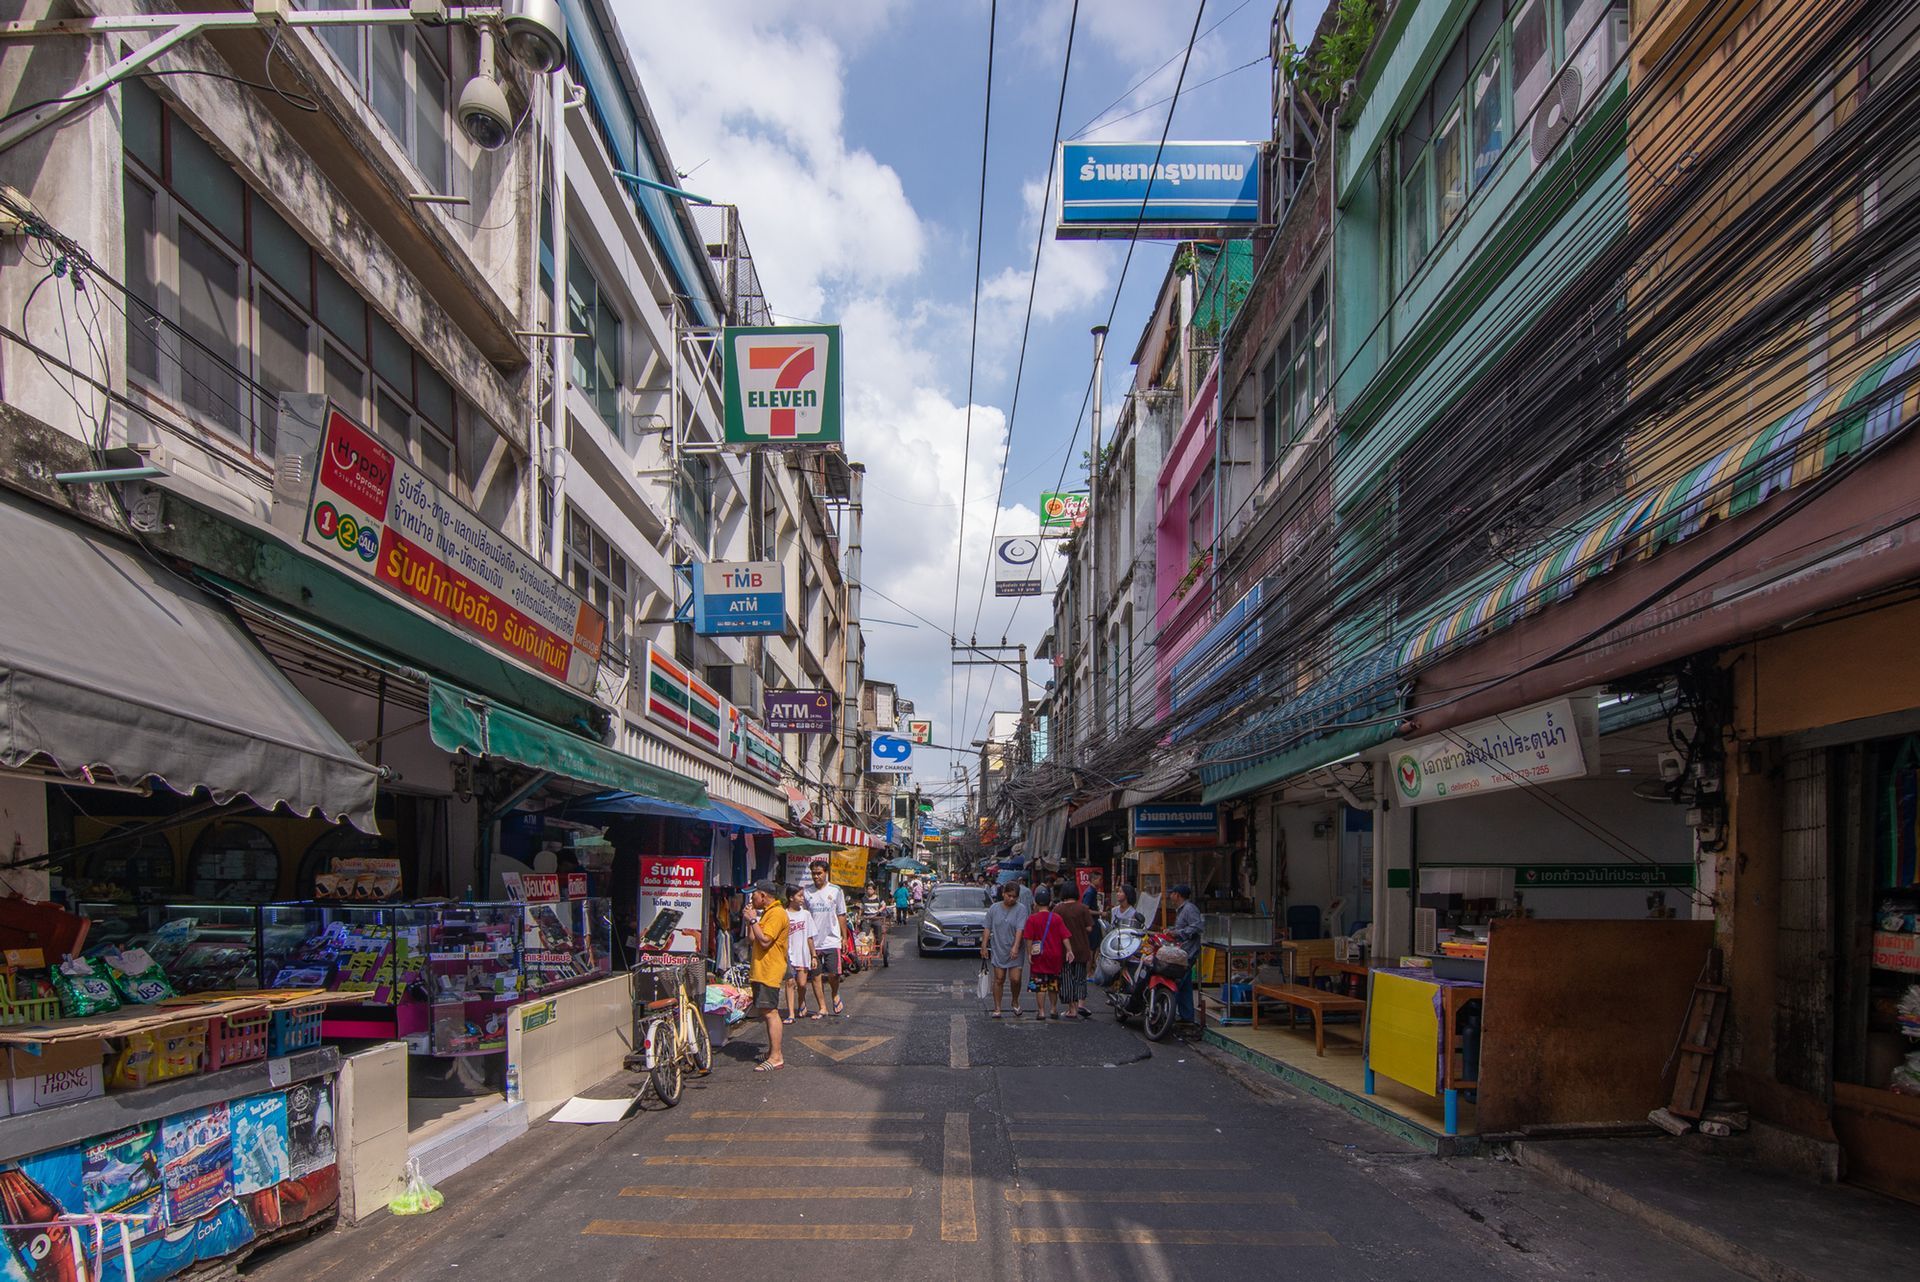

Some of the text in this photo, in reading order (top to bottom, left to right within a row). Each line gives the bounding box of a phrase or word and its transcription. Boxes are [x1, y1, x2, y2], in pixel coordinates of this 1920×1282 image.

[1080, 156, 1244, 185] ร้านยากรุงเทพ
[721, 568, 763, 588] TMB
[386, 541, 569, 672] รับฝากมือถือ รับเงินทันที
[729, 597, 758, 612] ATM
[770, 703, 809, 719] ATM
[1422, 712, 1567, 776] เอกข้าวมันไก่ประตูน้ำ
[523, 815, 537, 825] ATM
[651, 862, 695, 877] รับฝาก
[46, 1067, 84, 1084] HONG
[41, 1076, 88, 1095] THONG
[197, 1218, 223, 1240] COLA
